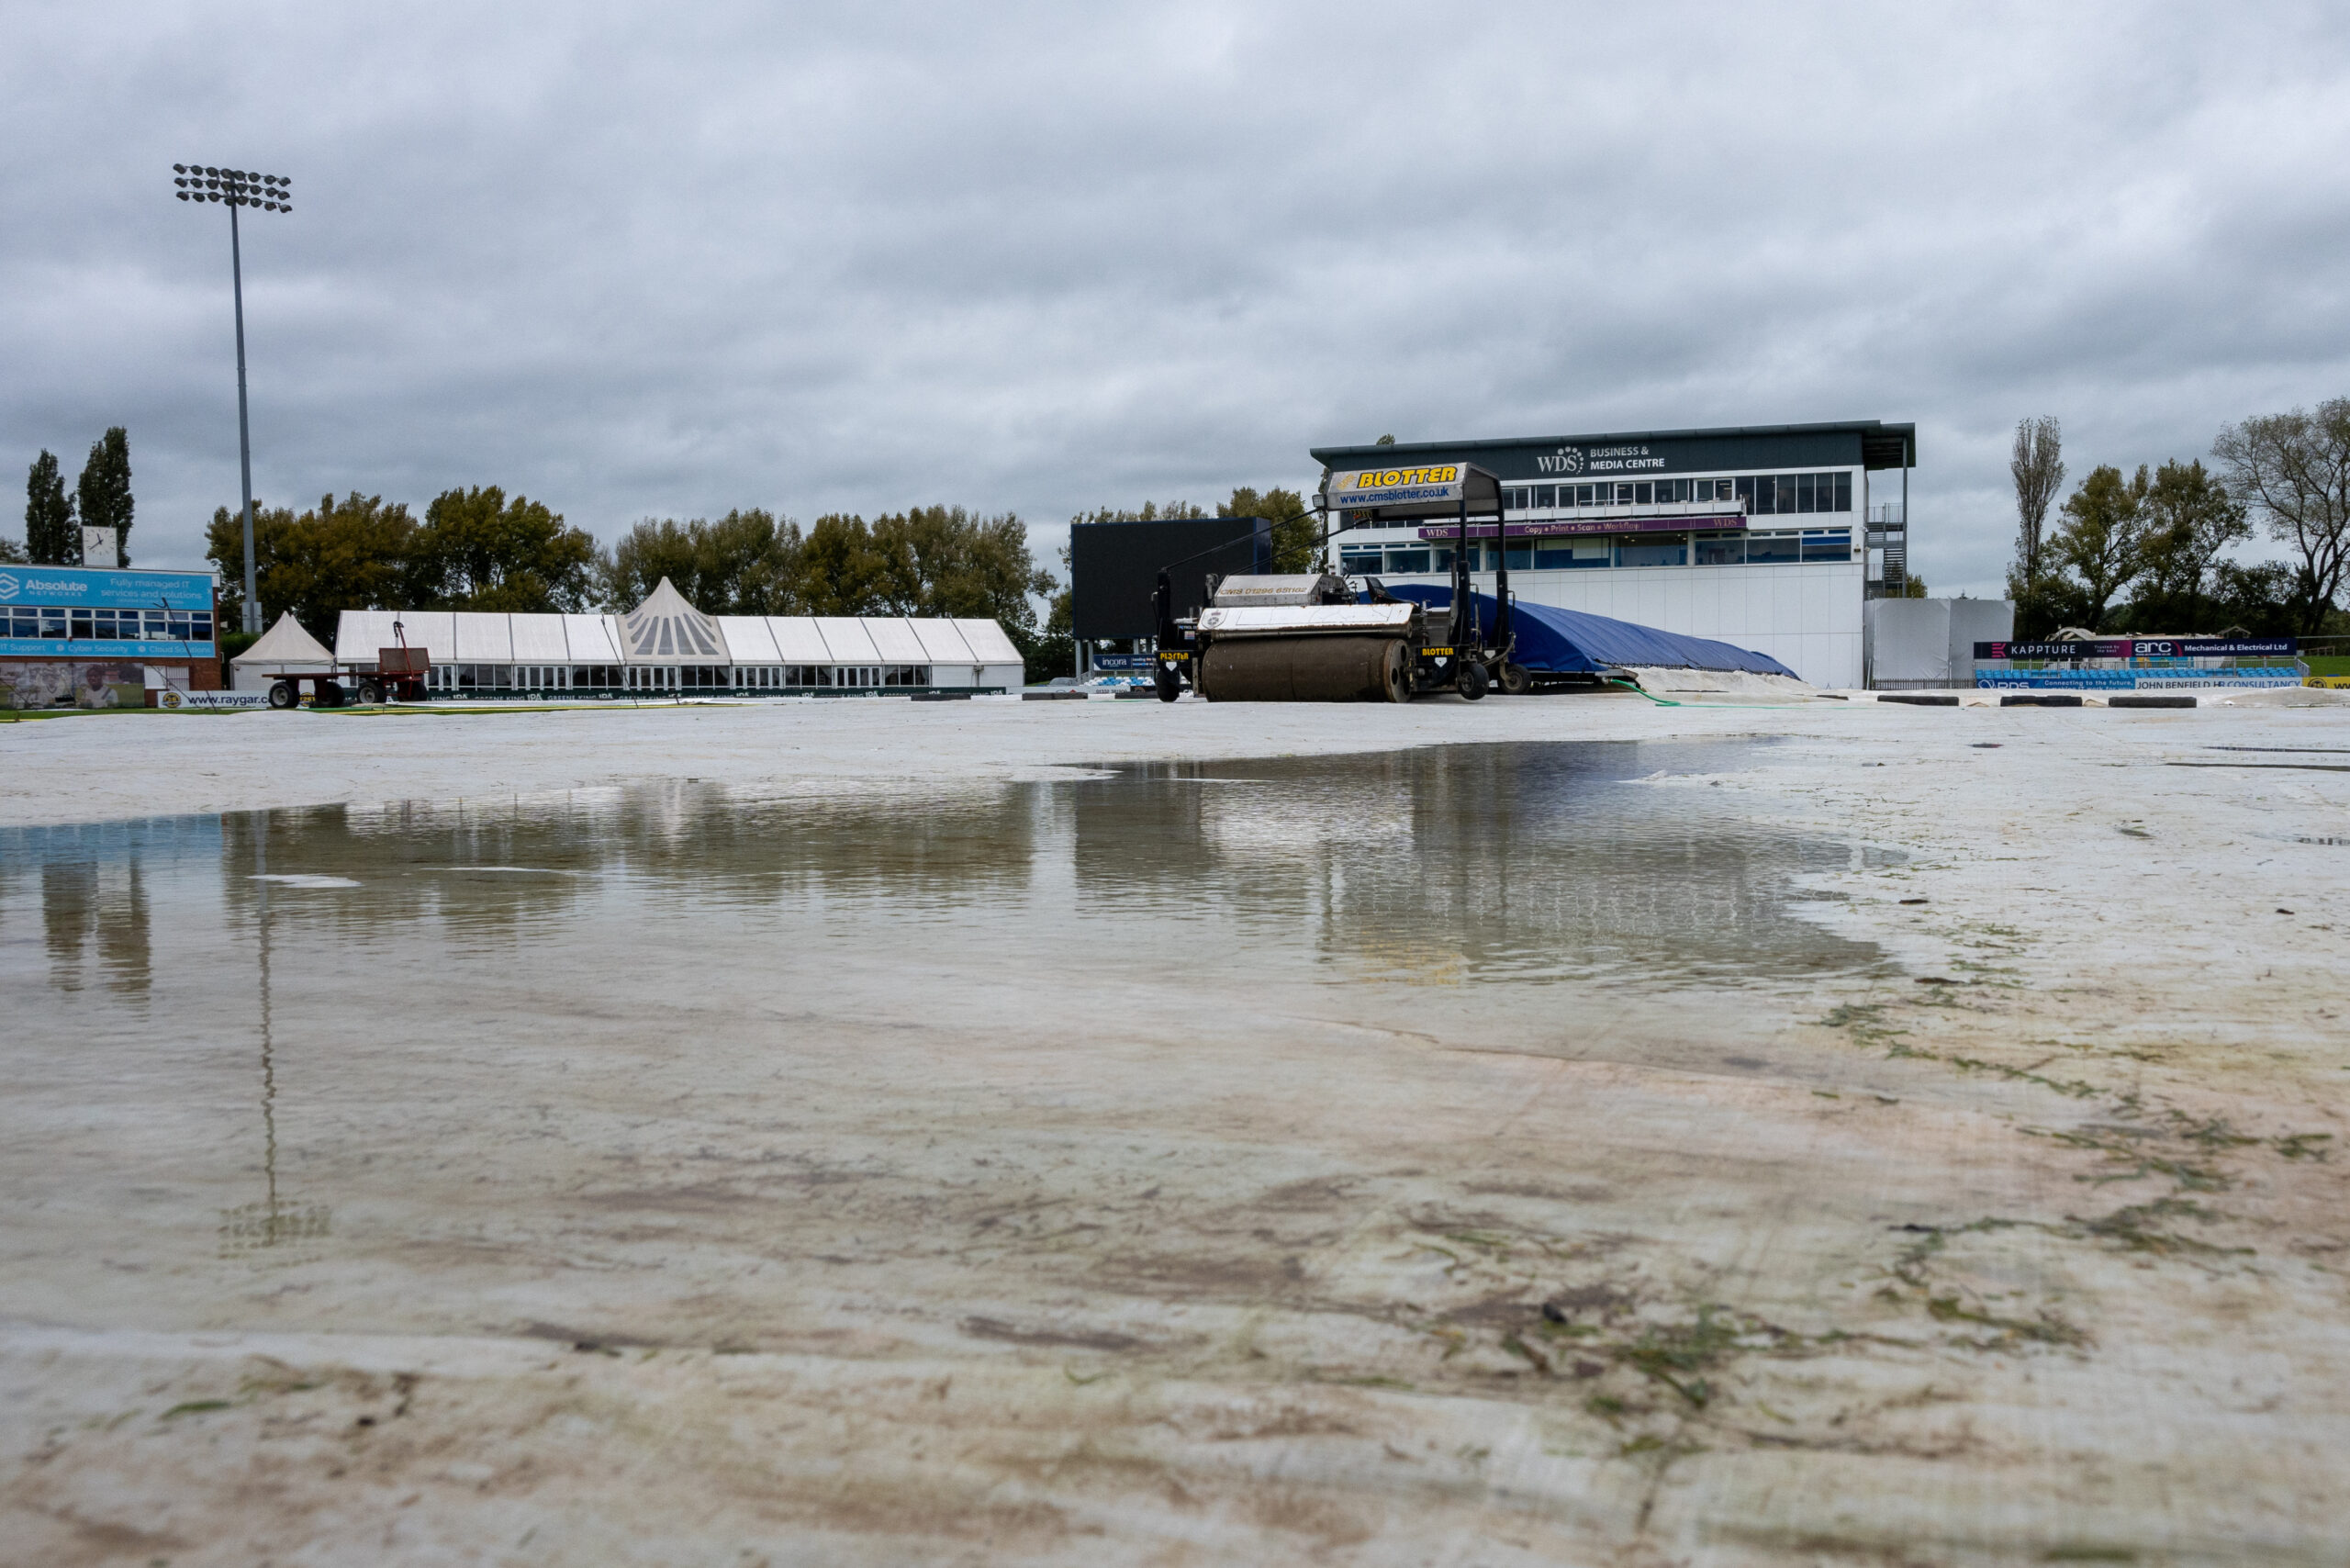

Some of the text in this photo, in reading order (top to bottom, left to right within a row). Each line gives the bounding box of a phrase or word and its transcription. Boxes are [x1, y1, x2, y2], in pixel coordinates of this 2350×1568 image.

[1590, 446, 1650, 457] BUSINESS &
[1537, 454, 1578, 472] WDS
[1590, 458, 1665, 470] MEDIA CENTRE
[1357, 466, 1458, 488] BLOTTER
[1339, 487, 1449, 504] www.cmsblotter.co.uk
[1525, 525, 1543, 534] Copy
[1577, 523, 1595, 532] Scan
[1604, 521, 1641, 530] Workflow
[1713, 518, 1738, 527] WDS
[1427, 528, 1449, 537] WDS
[26, 579, 88, 592] Absolute
[110, 578, 132, 588] Fully
[135, 580, 180, 589] managed
[101, 588, 202, 599] services and solutions
[95, 645, 129, 654] Security
[1422, 647, 1454, 656] BLOTTER
[2011, 645, 2076, 655] KAPPTURE
[2135, 642, 2172, 654] arc
[1102, 657, 1127, 666] incora
[2137, 681, 2163, 689] JOHN
